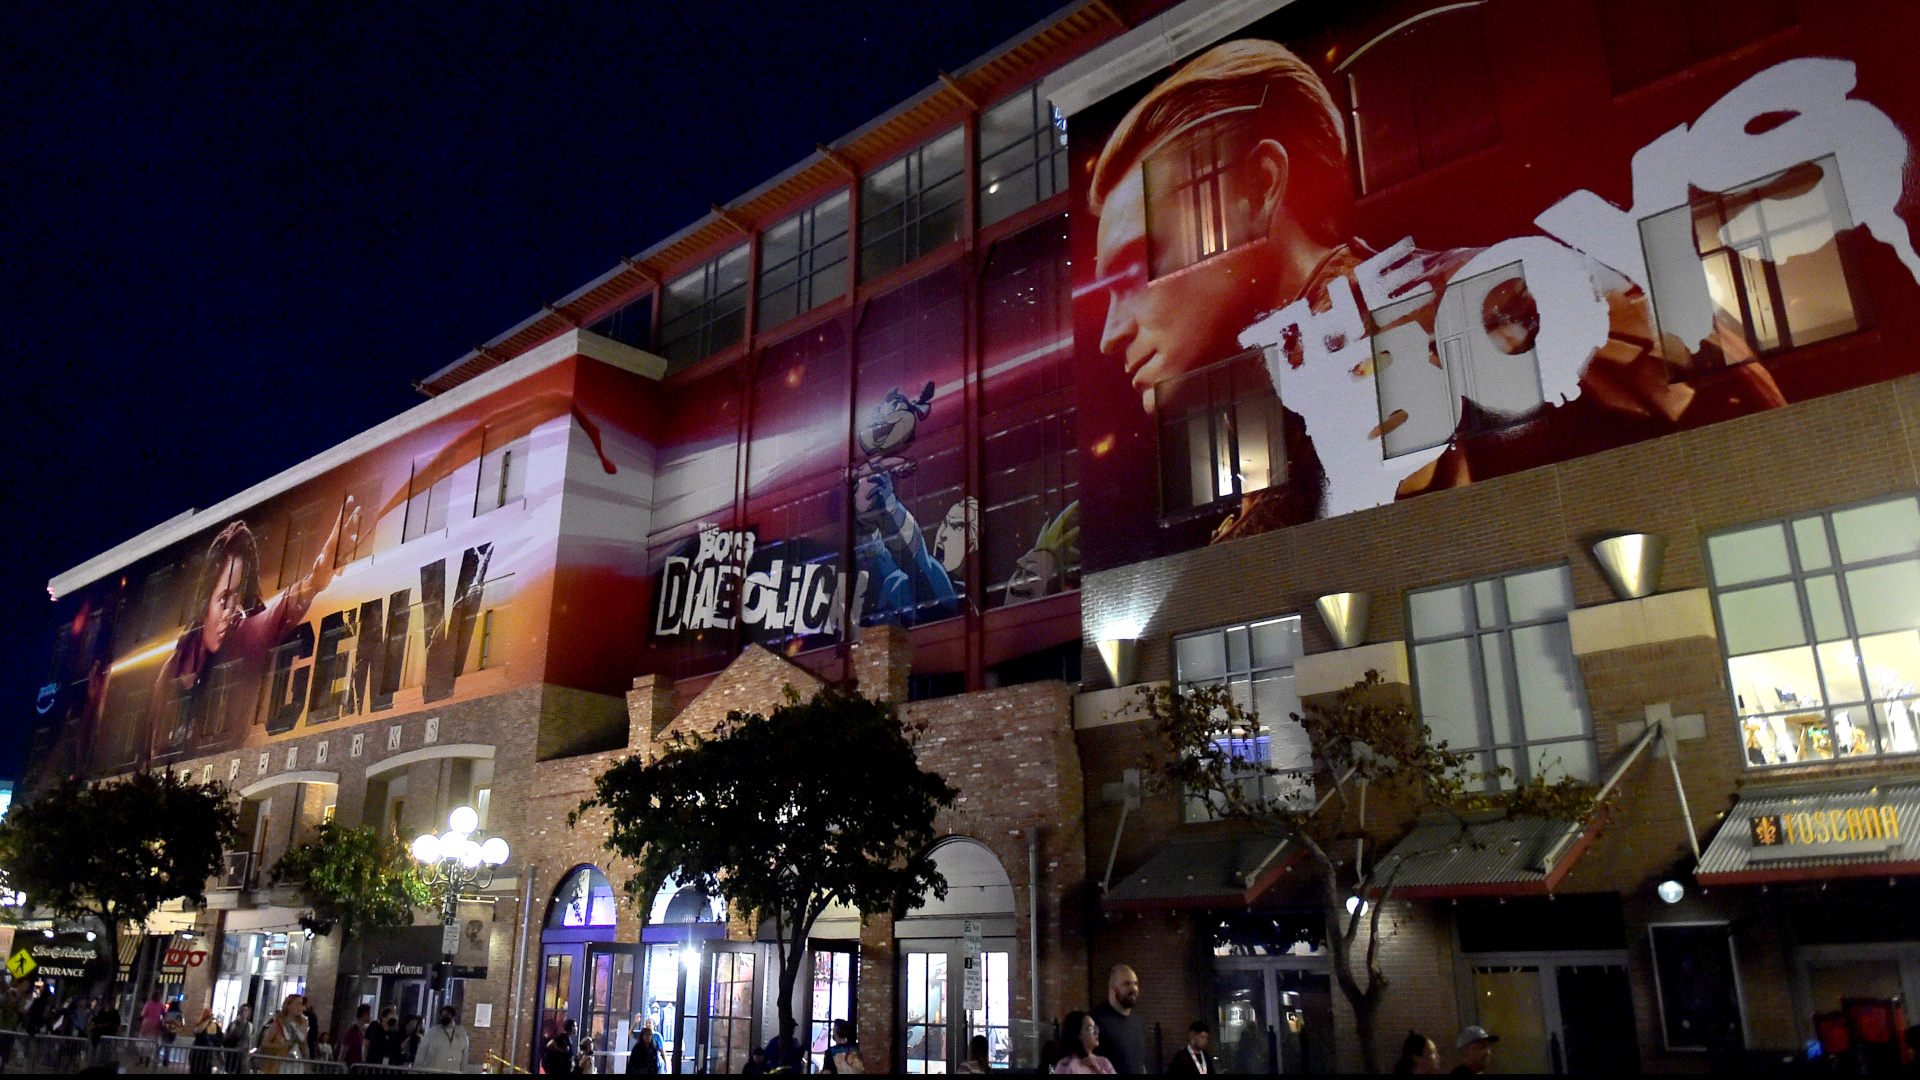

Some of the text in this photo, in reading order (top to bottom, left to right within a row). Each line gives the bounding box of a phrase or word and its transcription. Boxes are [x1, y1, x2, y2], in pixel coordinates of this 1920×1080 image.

[1237, 236, 1437, 374] THE
[265, 542, 494, 736] GEN V
[1783, 805, 1900, 845] TOSCANA
[38, 966, 86, 977] ENTRANCE
